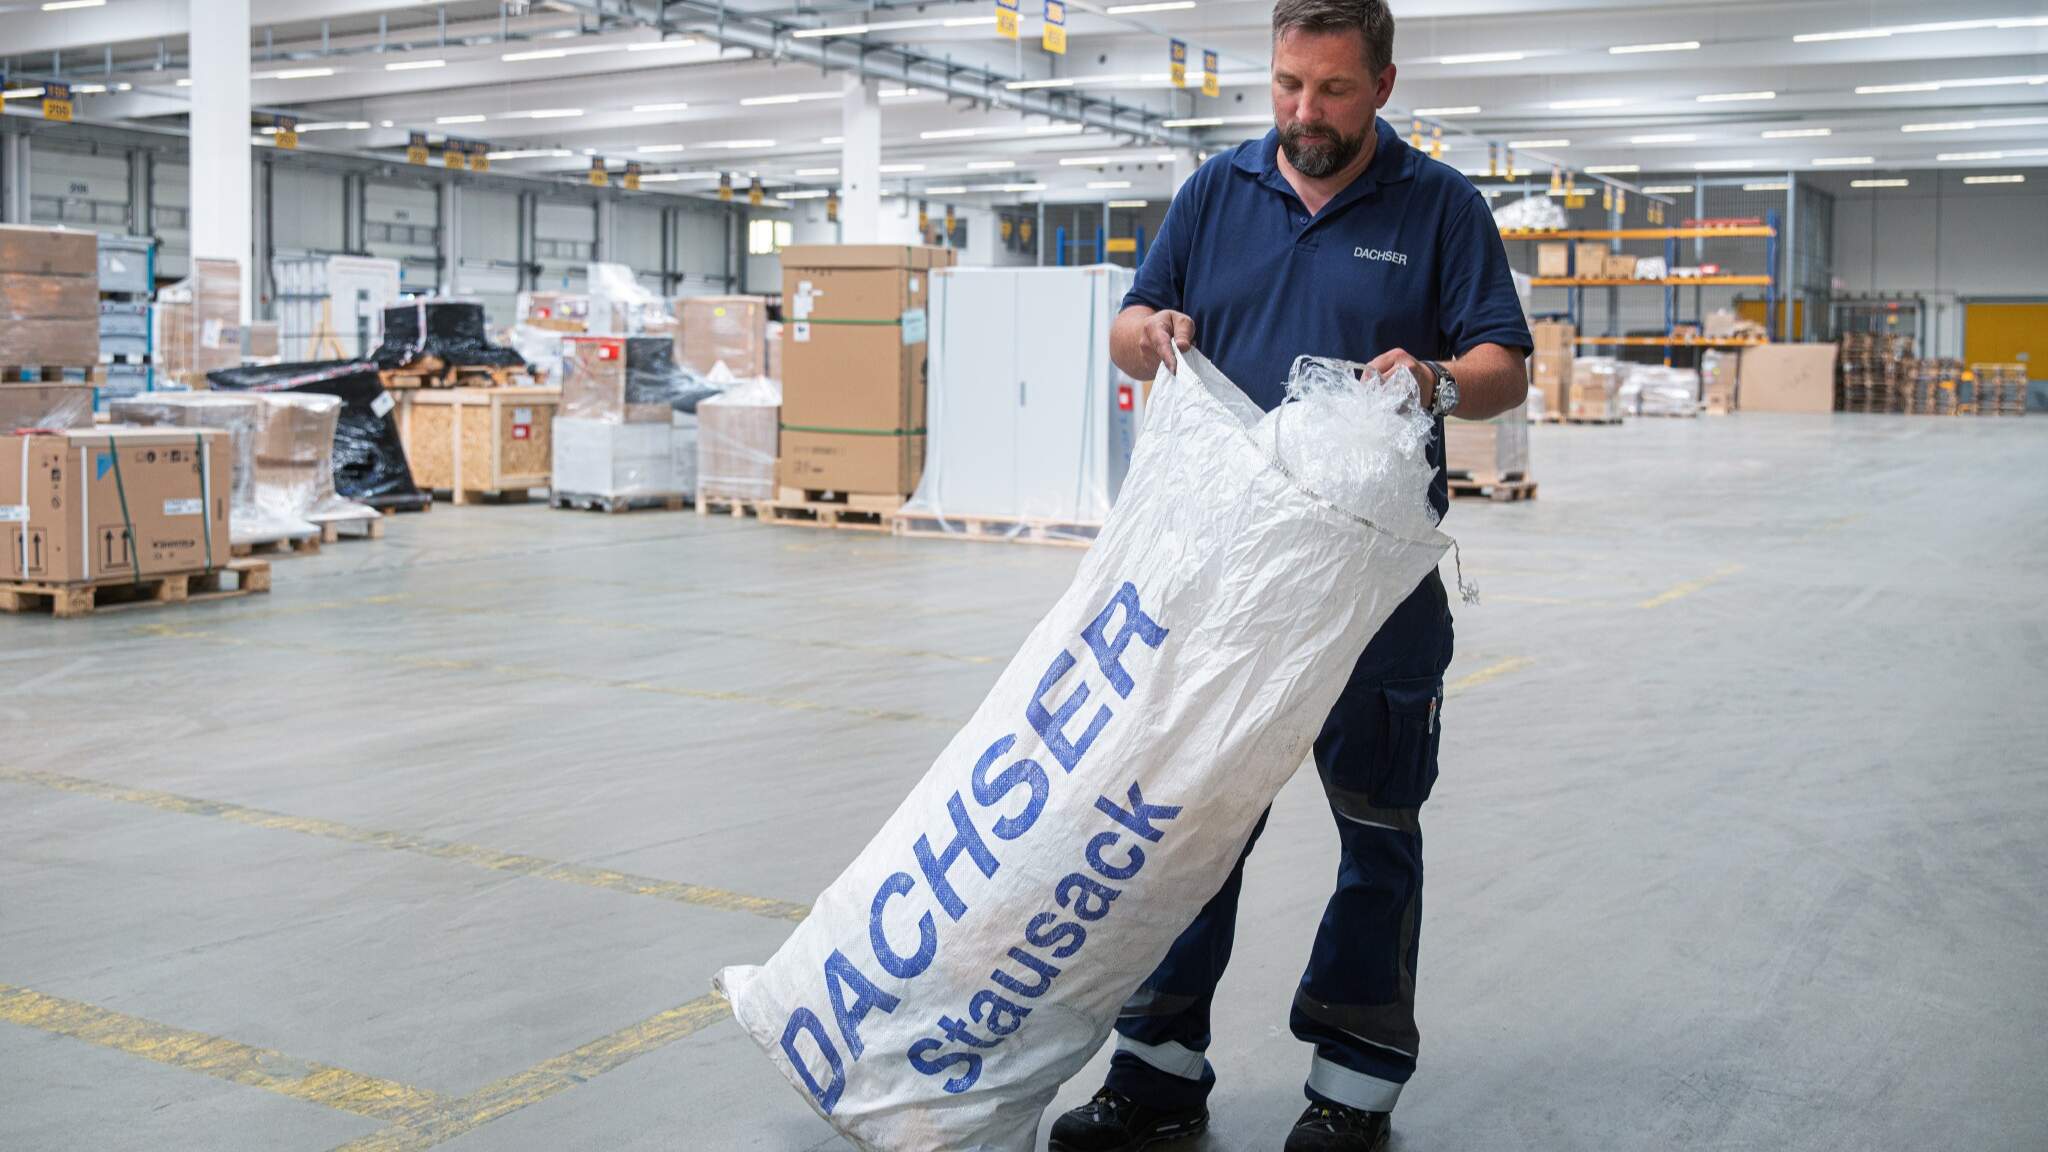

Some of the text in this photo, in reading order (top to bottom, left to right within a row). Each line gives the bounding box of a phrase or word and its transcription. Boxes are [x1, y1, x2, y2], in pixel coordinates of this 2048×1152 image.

[1353, 246, 1408, 266] DACHSER
[780, 581, 1169, 1115] DACHSER
[907, 781, 1183, 1094] Stausack
